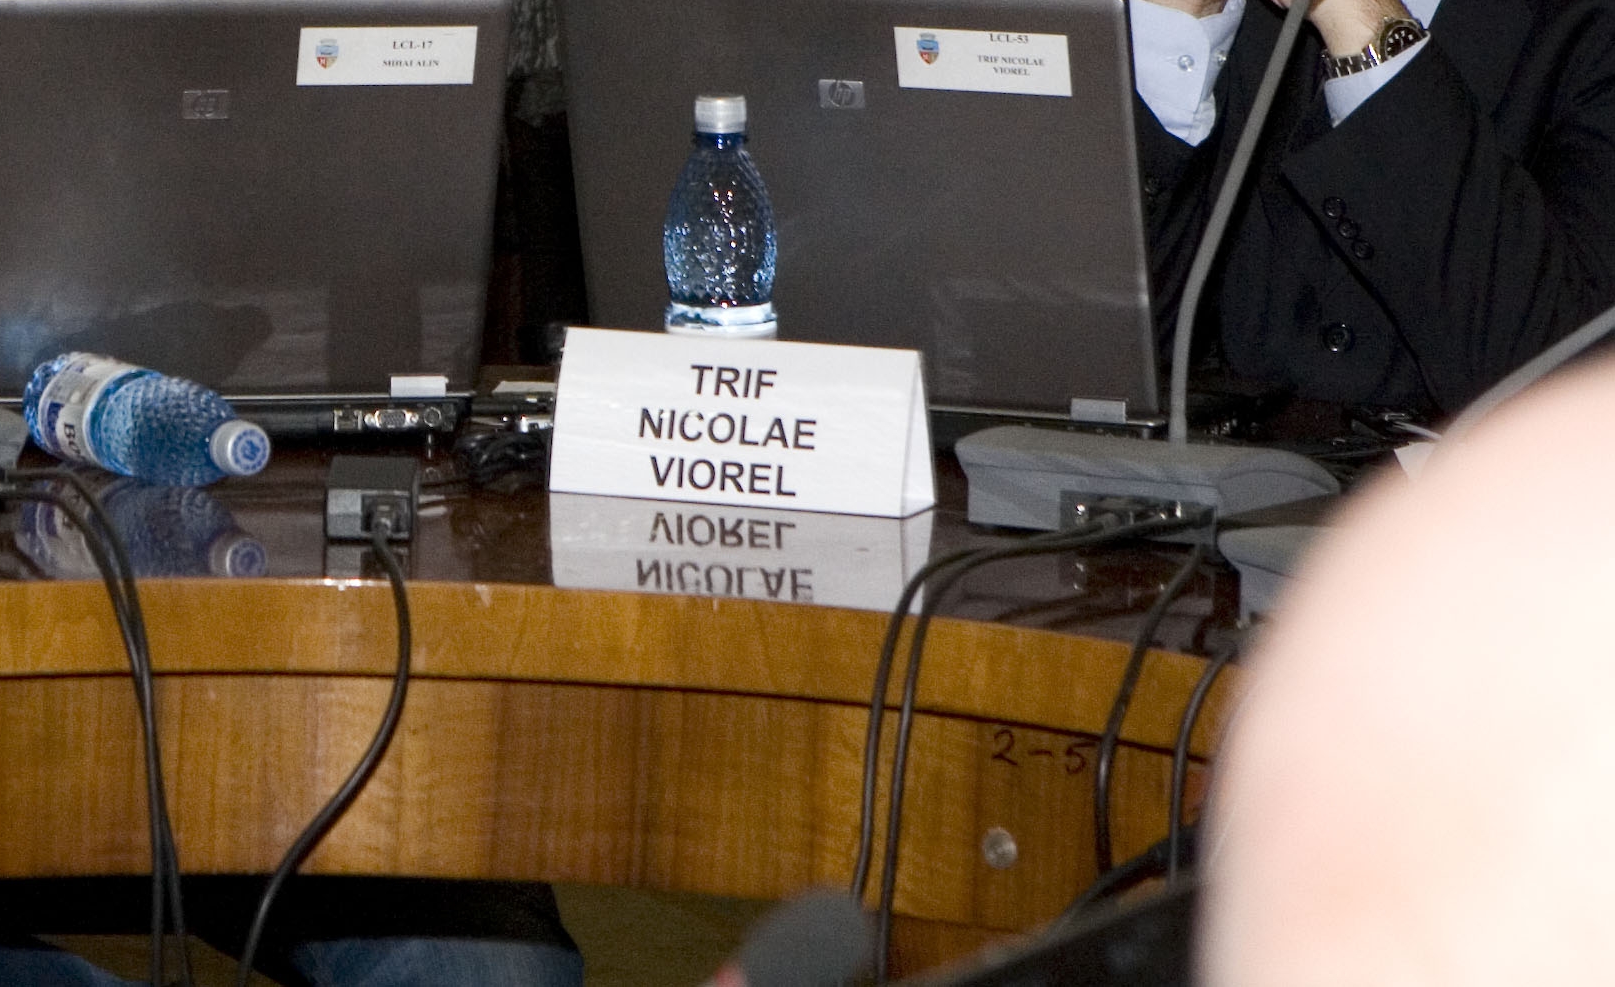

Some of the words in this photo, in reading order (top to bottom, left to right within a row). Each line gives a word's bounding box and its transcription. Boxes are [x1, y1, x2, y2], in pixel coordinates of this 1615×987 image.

[989, 32, 1029, 44] LCL-53
[392, 40, 433, 50] LCL-17
[977, 54, 1000, 64] TRIF
[1001, 56, 1046, 67] NICOLAE
[993, 66, 1031, 77] VIOREL
[691, 364, 778, 399] TRIF
[639, 408, 817, 449] NICOLAE
[650, 456, 797, 497] VIOREL
